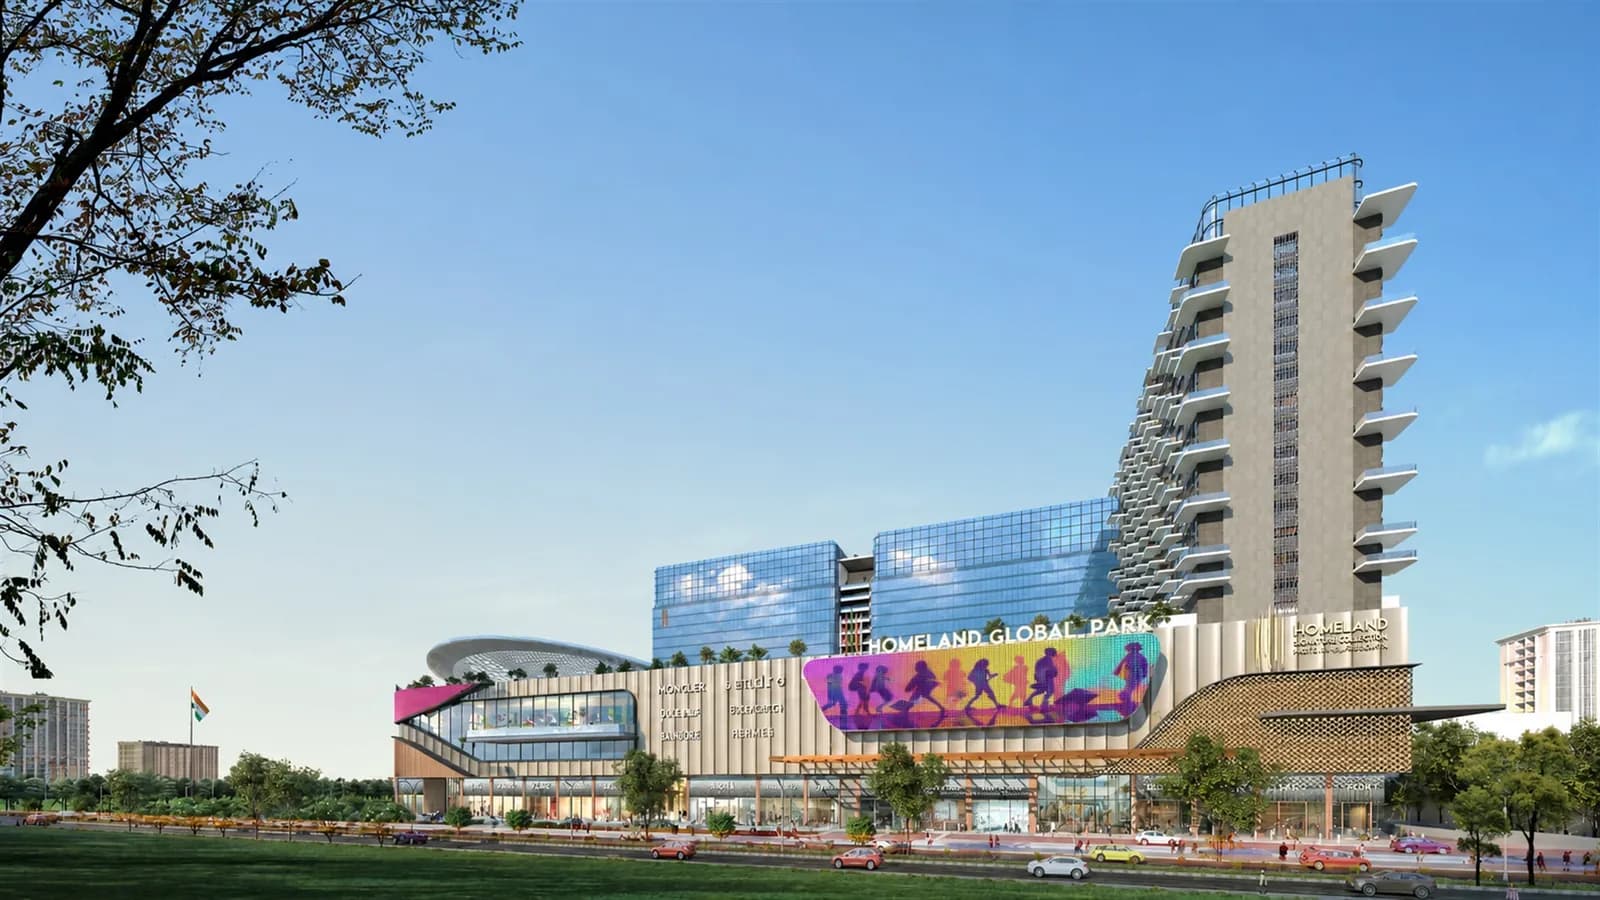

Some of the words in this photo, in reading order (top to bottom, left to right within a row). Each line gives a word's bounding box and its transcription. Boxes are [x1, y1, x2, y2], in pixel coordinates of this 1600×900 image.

[868, 630, 983, 655] HOMELAND
[989, 619, 1076, 645] GLOBAL
[1090, 614, 1154, 636] PARK
[1293, 617, 1389, 637] HOMELAND
